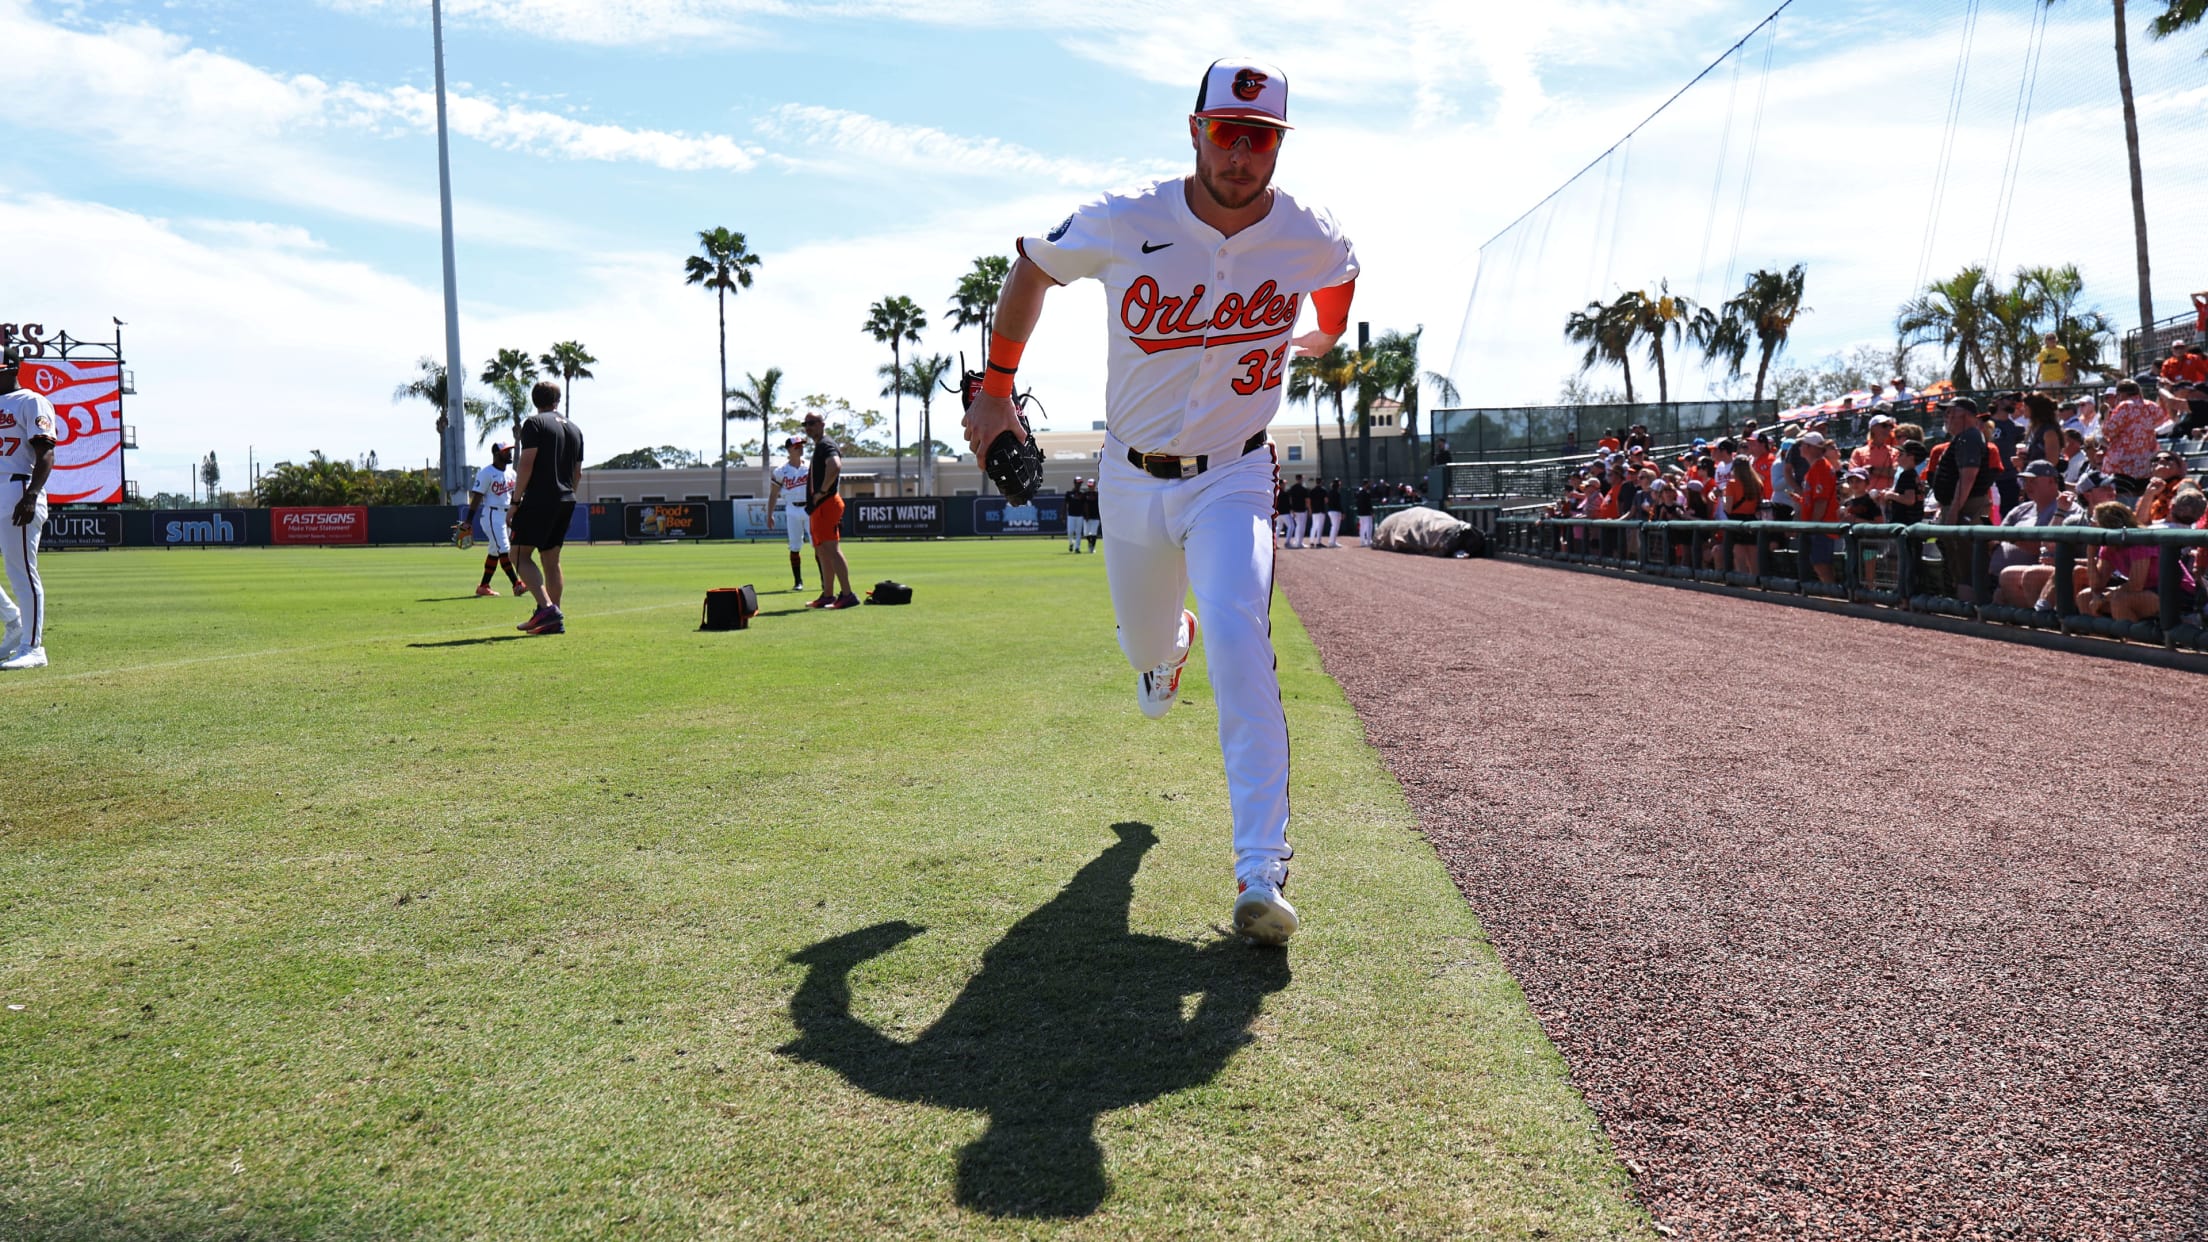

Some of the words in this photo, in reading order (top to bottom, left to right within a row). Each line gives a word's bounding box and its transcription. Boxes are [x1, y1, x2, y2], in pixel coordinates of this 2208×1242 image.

[1121, 275, 1299, 335] Orioles
[1231, 341, 1289, 395] 32
[0, 437, 21, 456] 7
[283, 513, 356, 525] FASTSIGNS
[655, 505, 682, 517] Food
[859, 506, 893, 522] FIRST
[896, 505, 936, 521] WATCH
[166, 513, 234, 542] smh
[666, 517, 693, 528] Beer
